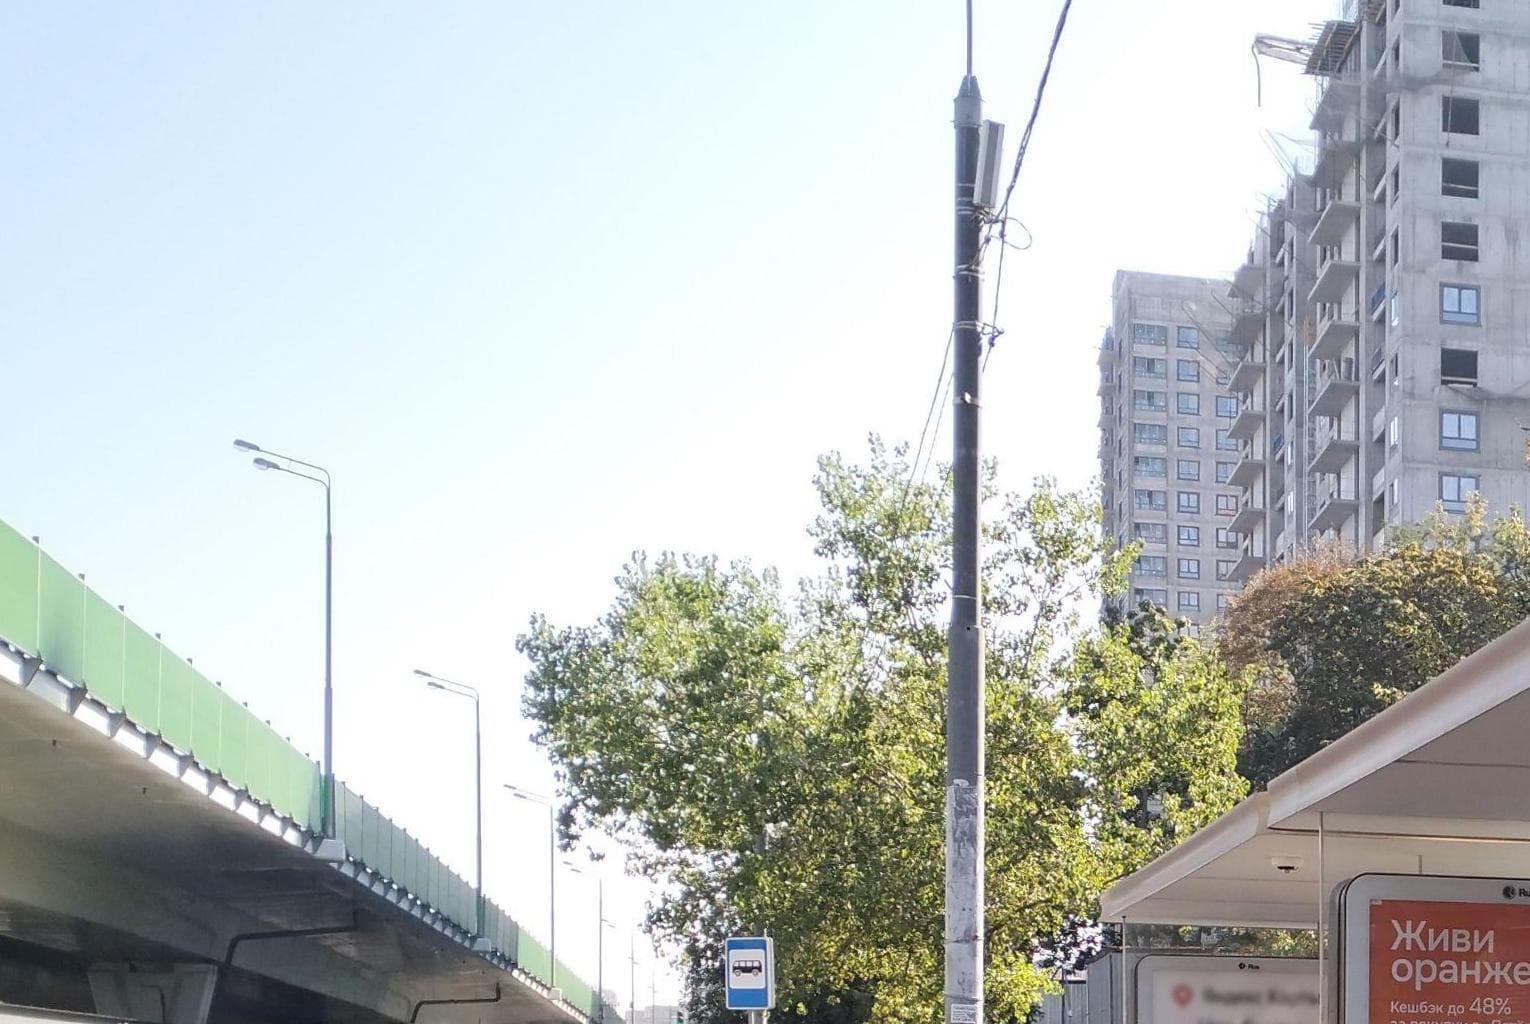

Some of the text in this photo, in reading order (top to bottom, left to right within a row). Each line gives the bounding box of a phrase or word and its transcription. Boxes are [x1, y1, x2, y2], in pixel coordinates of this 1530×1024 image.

[1391, 919, 1495, 953] Живи
[1390, 997, 1512, 1016] Кешбэк до 48%
